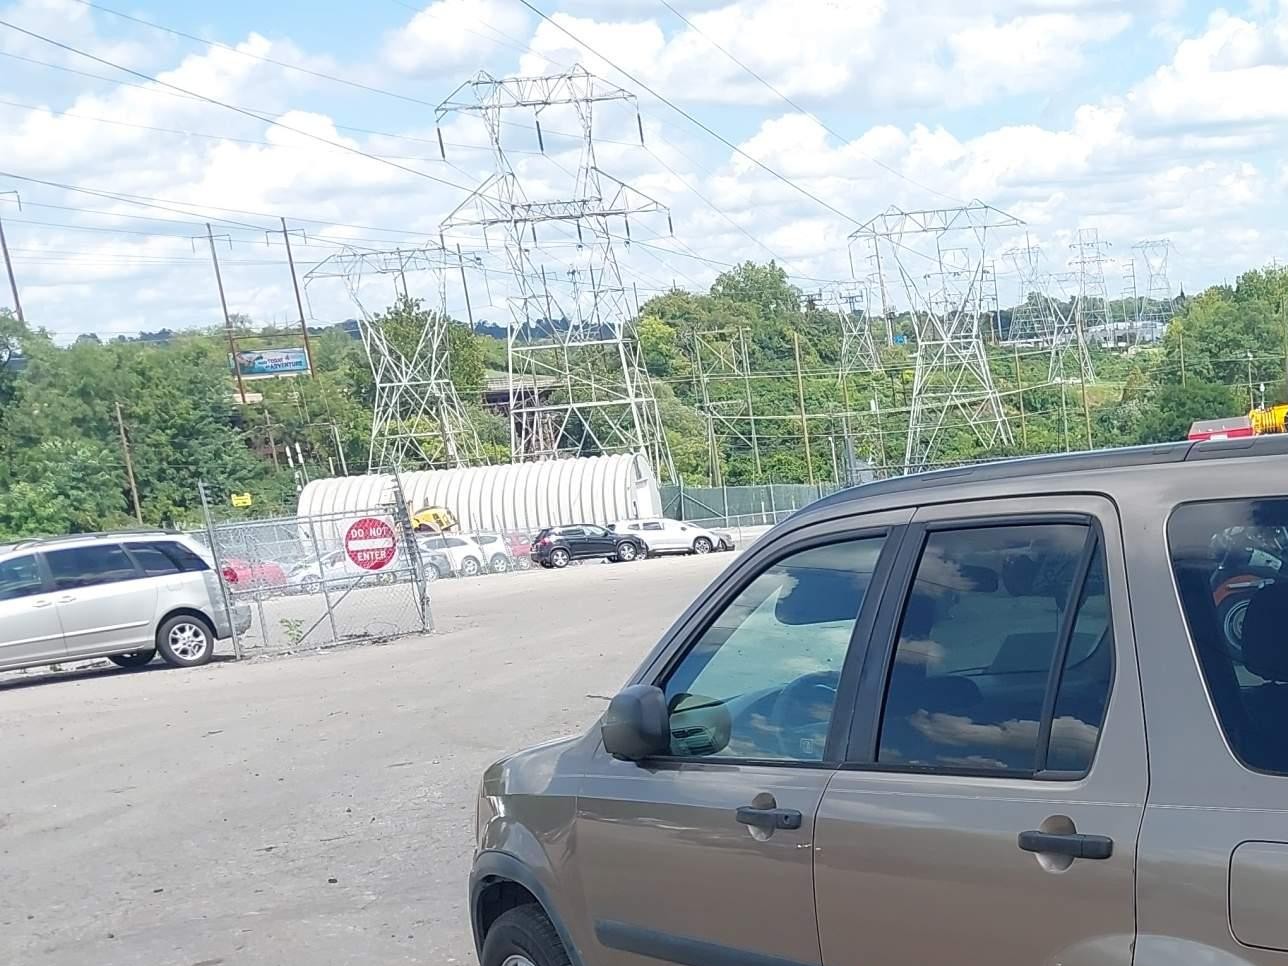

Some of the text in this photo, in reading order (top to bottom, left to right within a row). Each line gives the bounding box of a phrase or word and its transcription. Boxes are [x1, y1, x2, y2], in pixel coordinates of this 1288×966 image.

[350, 527, 389, 538] DO NOT
[357, 550, 387, 561] ENTER
